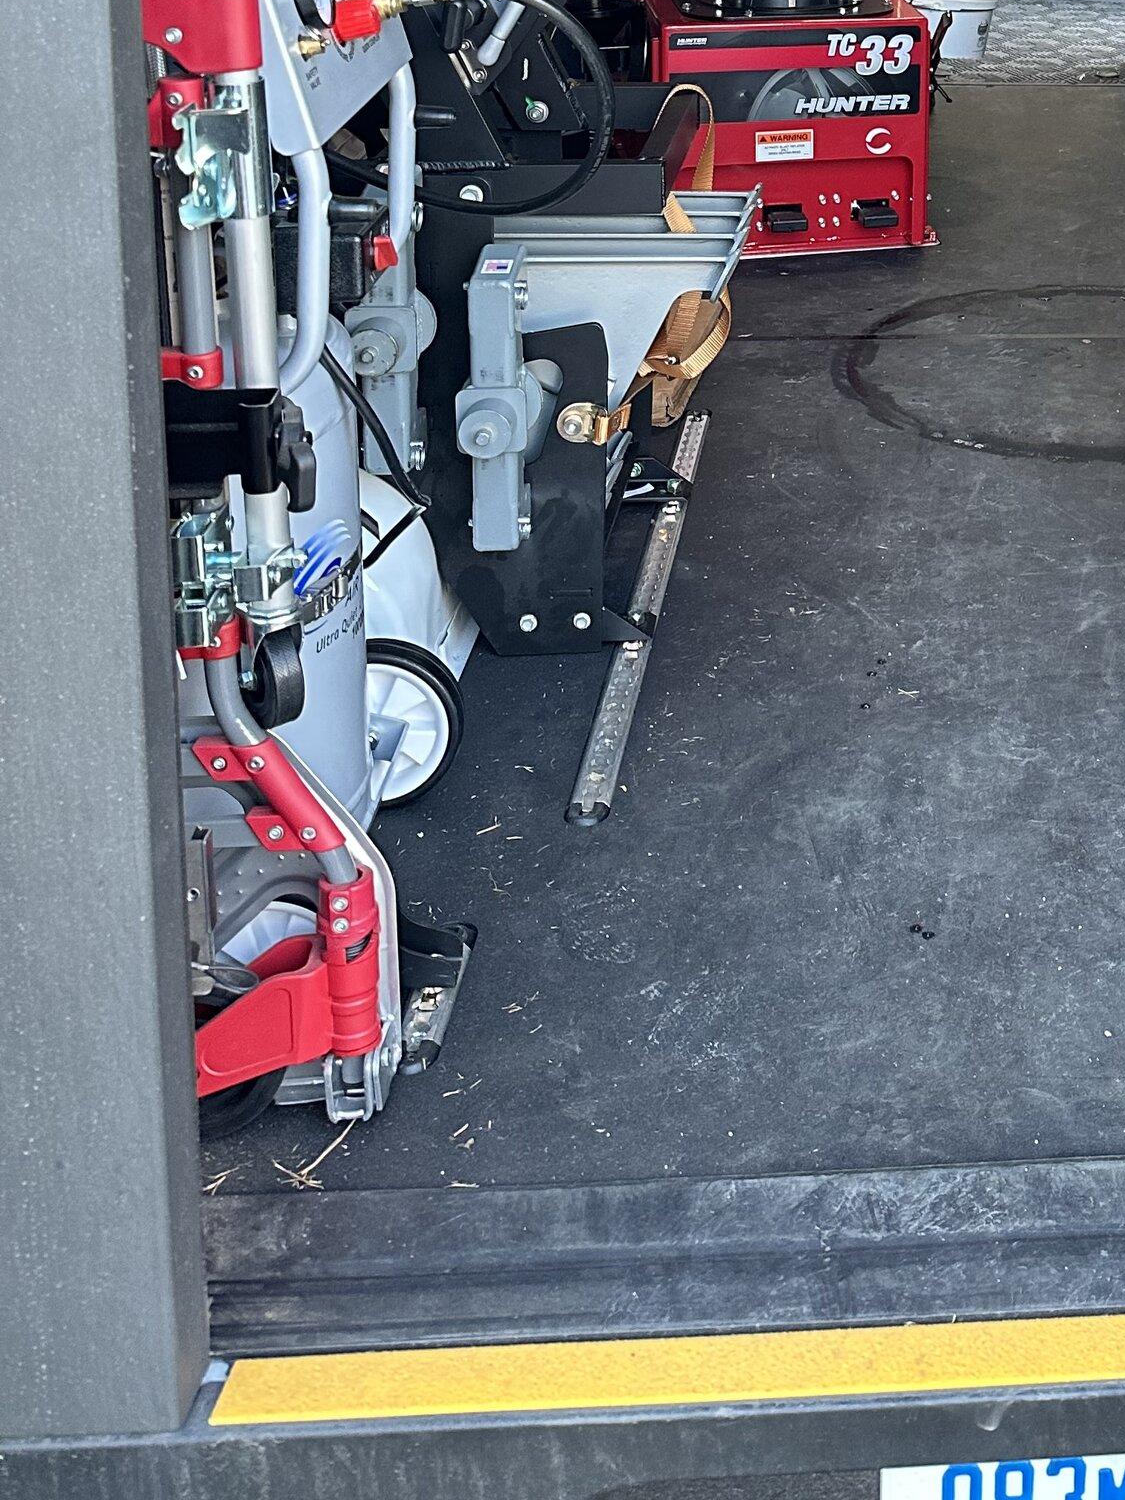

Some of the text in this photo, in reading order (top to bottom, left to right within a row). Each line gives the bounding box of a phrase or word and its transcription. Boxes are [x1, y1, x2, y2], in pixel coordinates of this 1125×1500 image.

[794, 94, 911, 114] HUNTER
[770, 132, 808, 143] WARNING
[315, 627, 340, 654] Ultra
